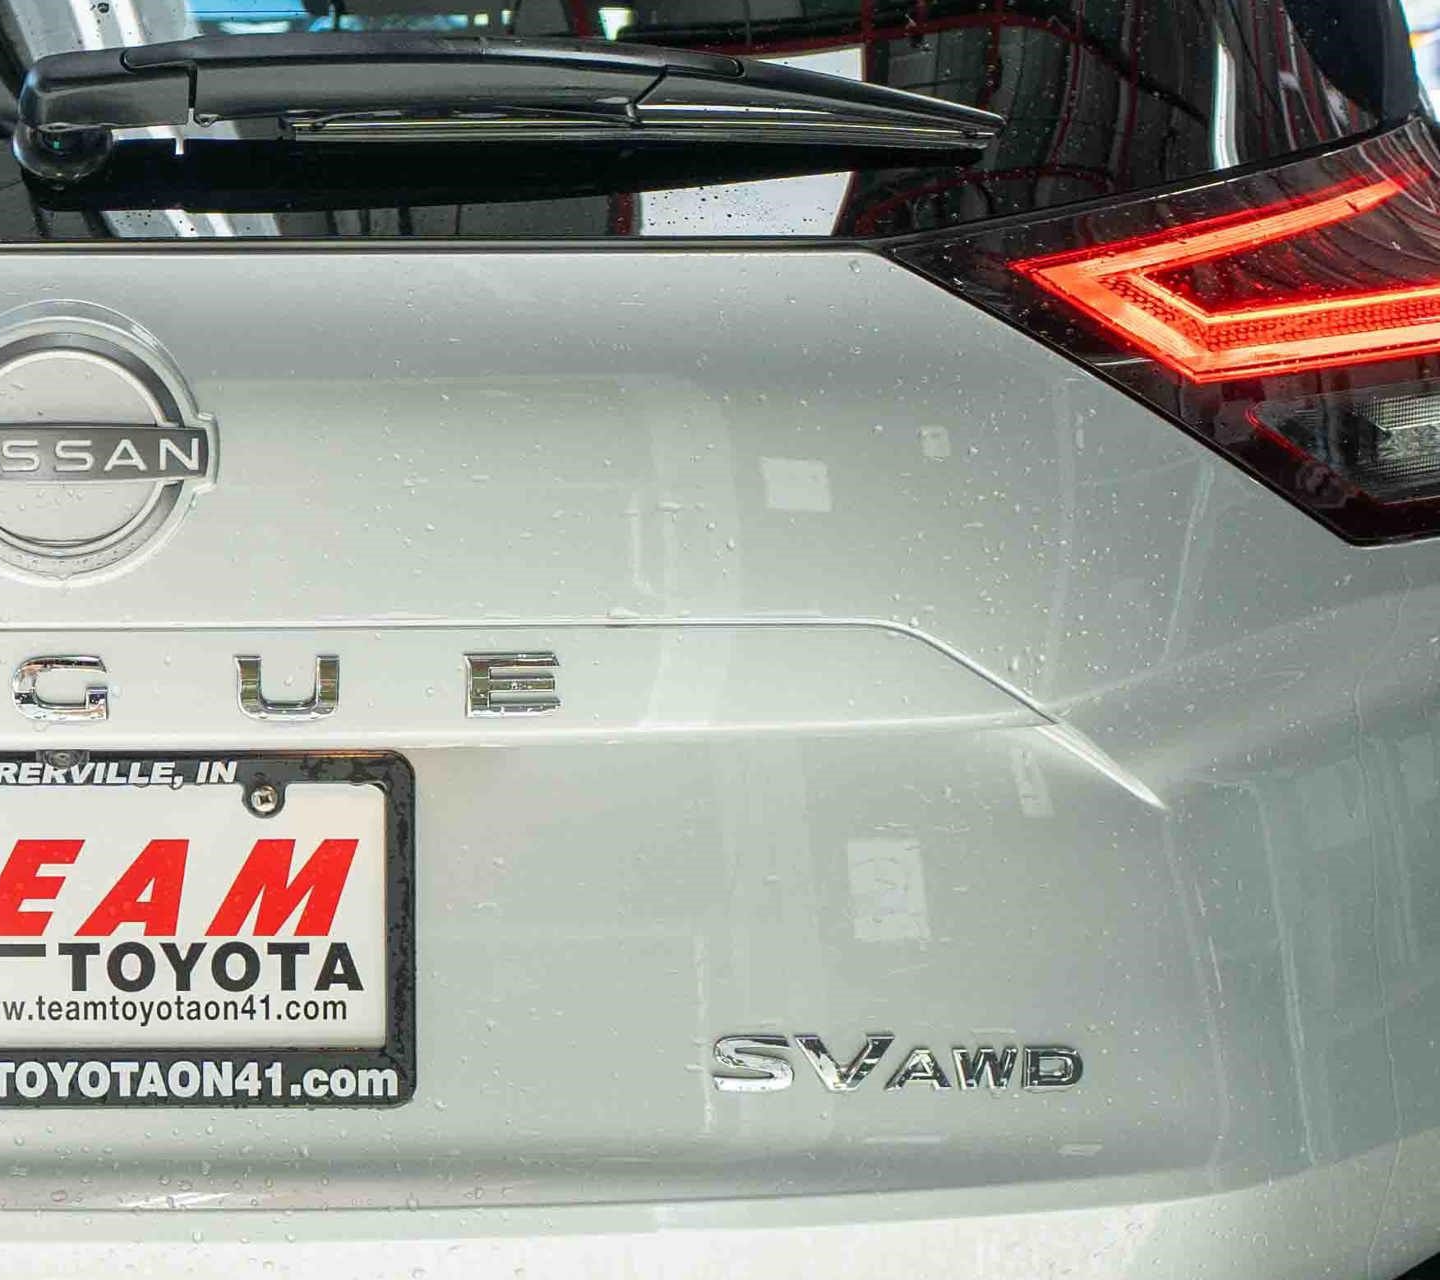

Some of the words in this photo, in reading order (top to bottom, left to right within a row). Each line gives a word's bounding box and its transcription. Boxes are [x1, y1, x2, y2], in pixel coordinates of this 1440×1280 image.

[195, 762, 239, 784] IN
[58, 941, 363, 992] TOYOTA
[712, 1034, 896, 1094] SV
[884, 1046, 1085, 1094] AWD
